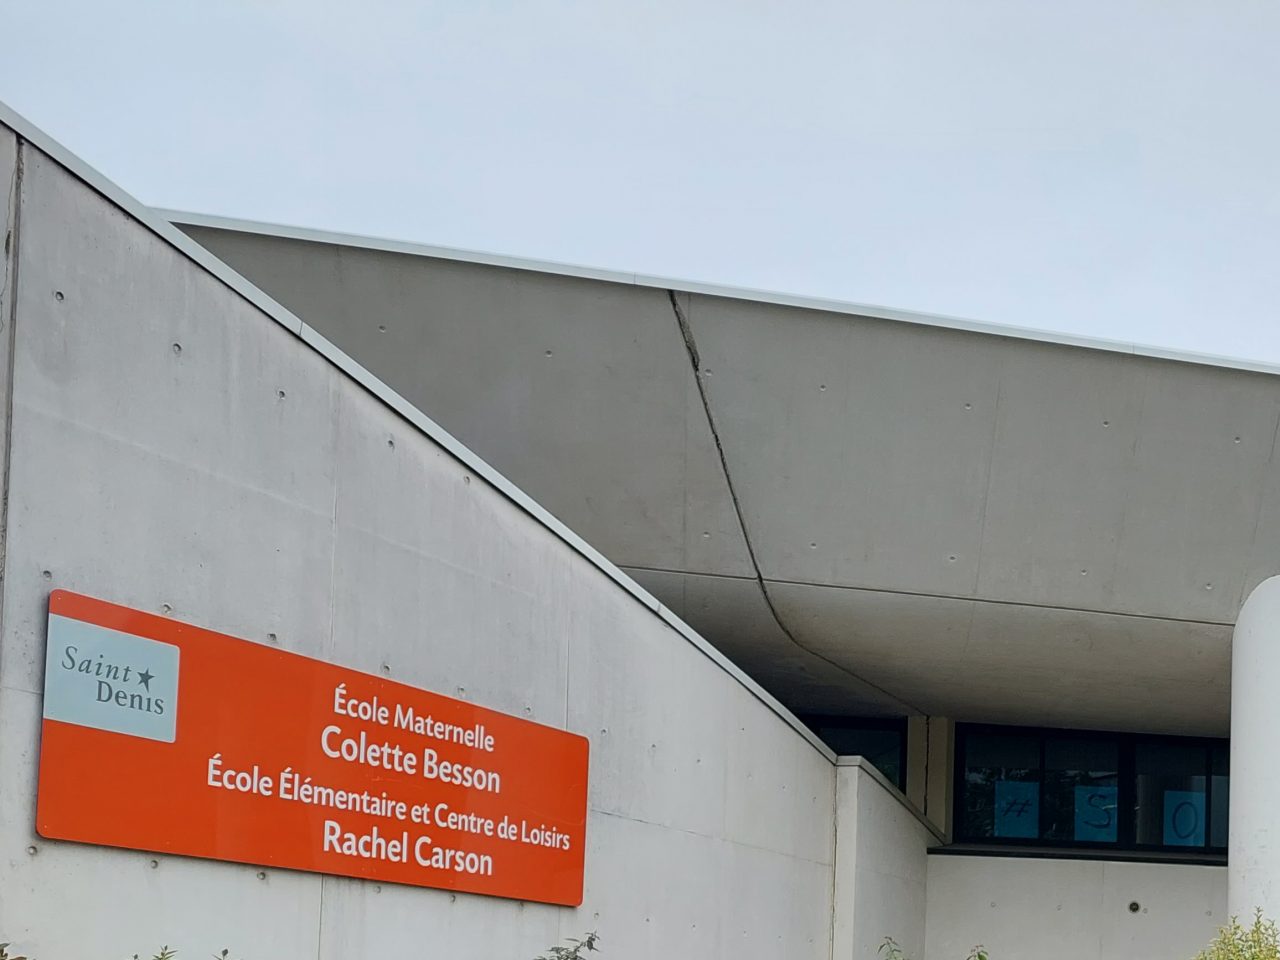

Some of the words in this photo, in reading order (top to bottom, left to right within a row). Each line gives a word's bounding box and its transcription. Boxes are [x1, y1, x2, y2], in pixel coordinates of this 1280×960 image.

[62, 645, 132, 683] Saint
[96, 680, 164, 715] Denis
[334, 683, 389, 725] École
[393, 703, 495, 752] Maternelle
[321, 725, 417, 775] Colette
[423, 748, 500, 794] Besson
[207, 753, 273, 796] École
[279, 767, 407, 820] Élémentaire
[411, 803, 430, 825] et
[434, 803, 494, 836] Centre
[497, 815, 518, 841] de
[521, 820, 570, 850] Loisirs
[323, 820, 408, 864] Rachel
[414, 836, 493, 876] Carson
